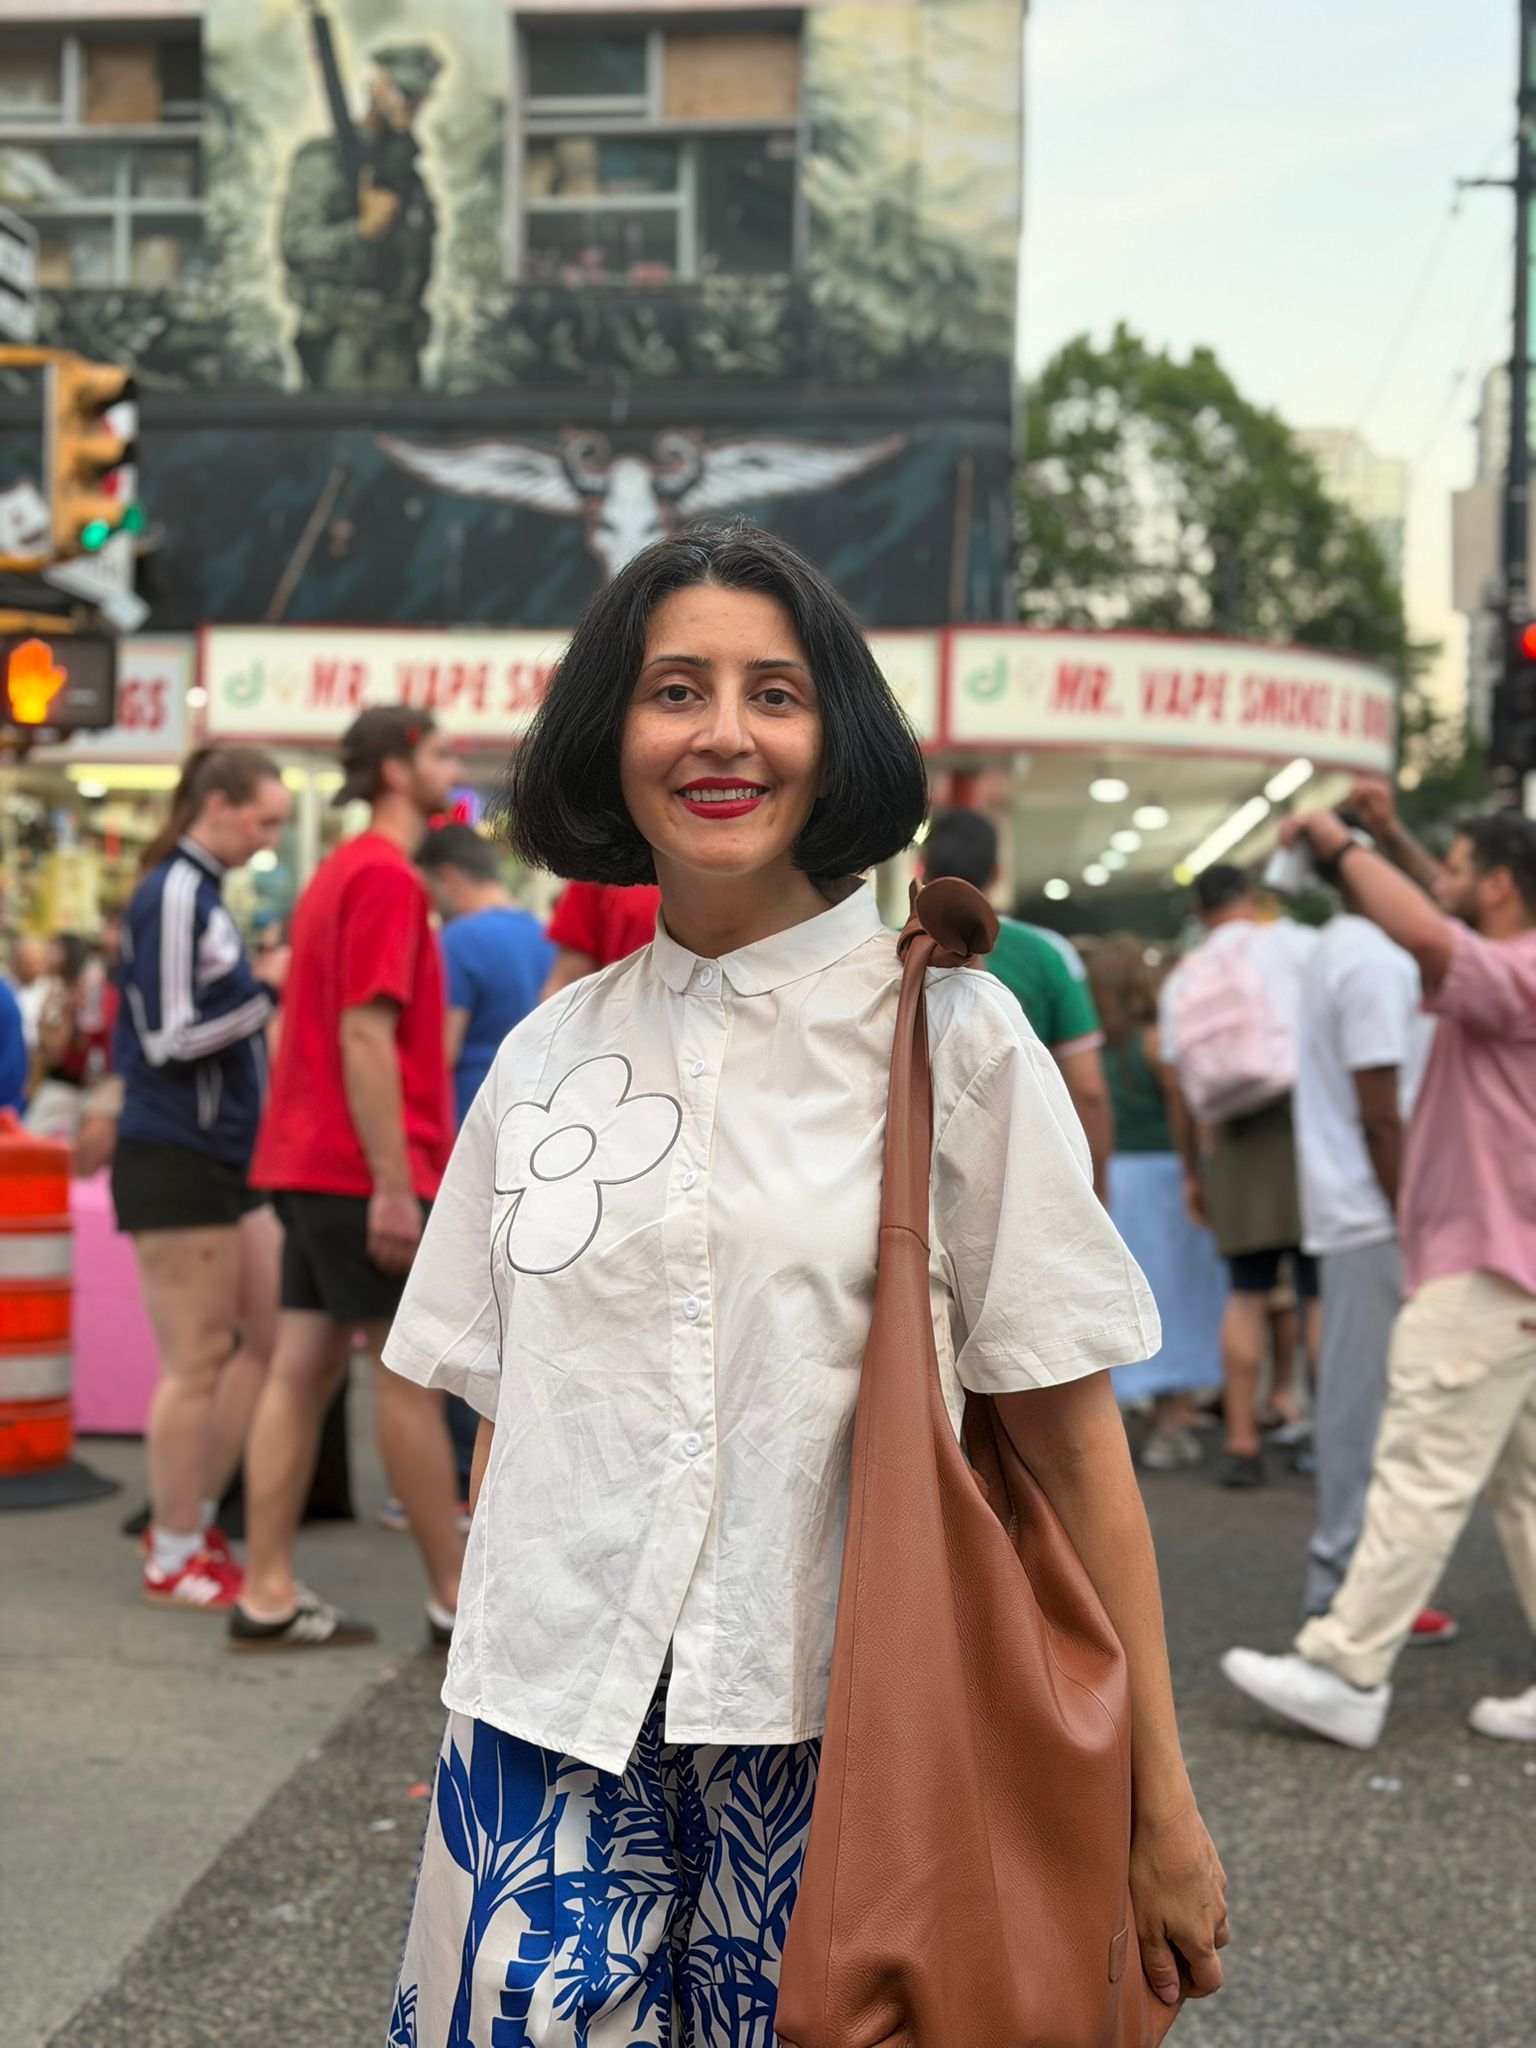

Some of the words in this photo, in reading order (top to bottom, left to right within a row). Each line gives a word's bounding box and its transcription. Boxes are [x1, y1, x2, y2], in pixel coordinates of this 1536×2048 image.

[395, 660, 488, 713] VAPE
[1139, 666, 1229, 724] VAPE
[1240, 673, 1332, 731] SMOKE
